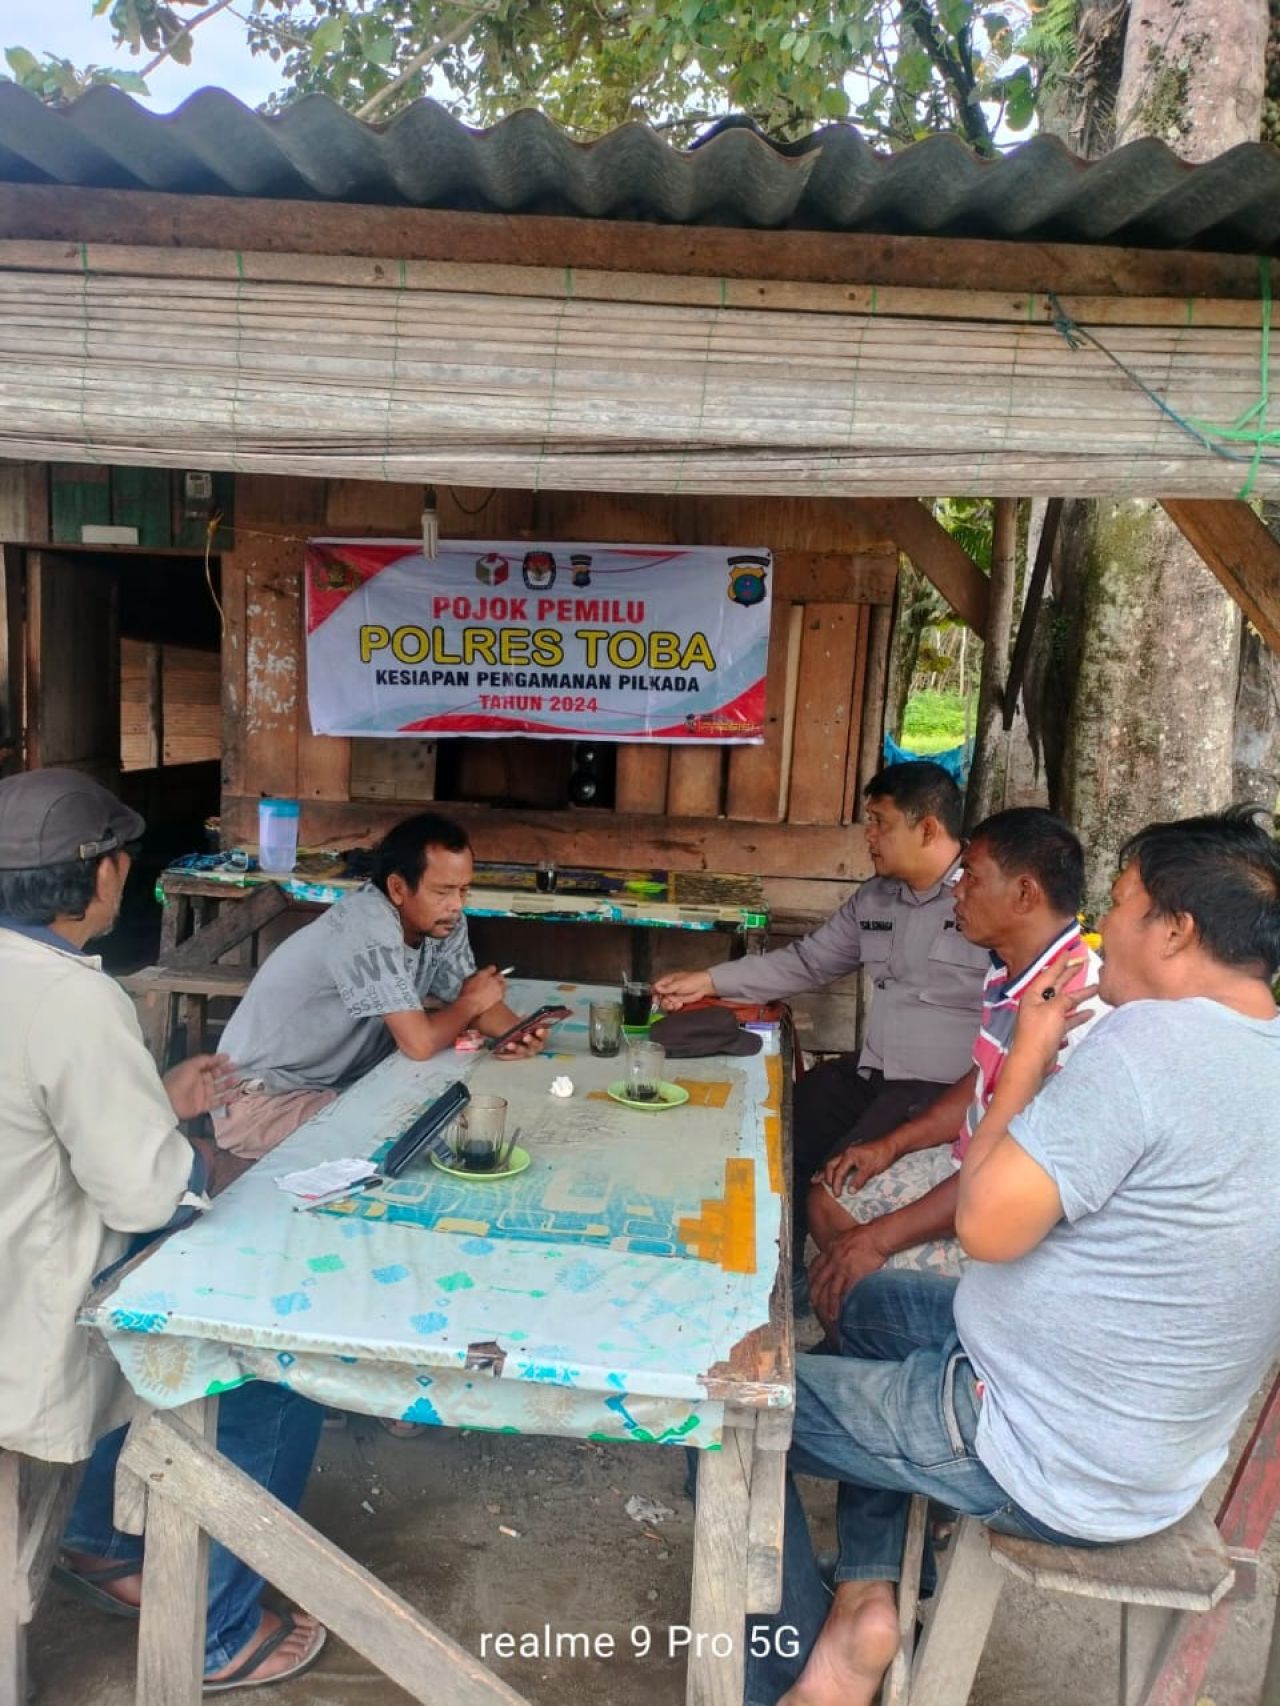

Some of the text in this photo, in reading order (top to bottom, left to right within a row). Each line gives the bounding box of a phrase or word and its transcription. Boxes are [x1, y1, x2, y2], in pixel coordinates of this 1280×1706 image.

[432, 596, 645, 624] POJOK PEMILU
[359, 625, 717, 672] POLRES TOBA
[375, 669, 700, 692] KESIAPAN PENGAMANAN PILKADA
[479, 694, 598, 712] TAHUN 2024
